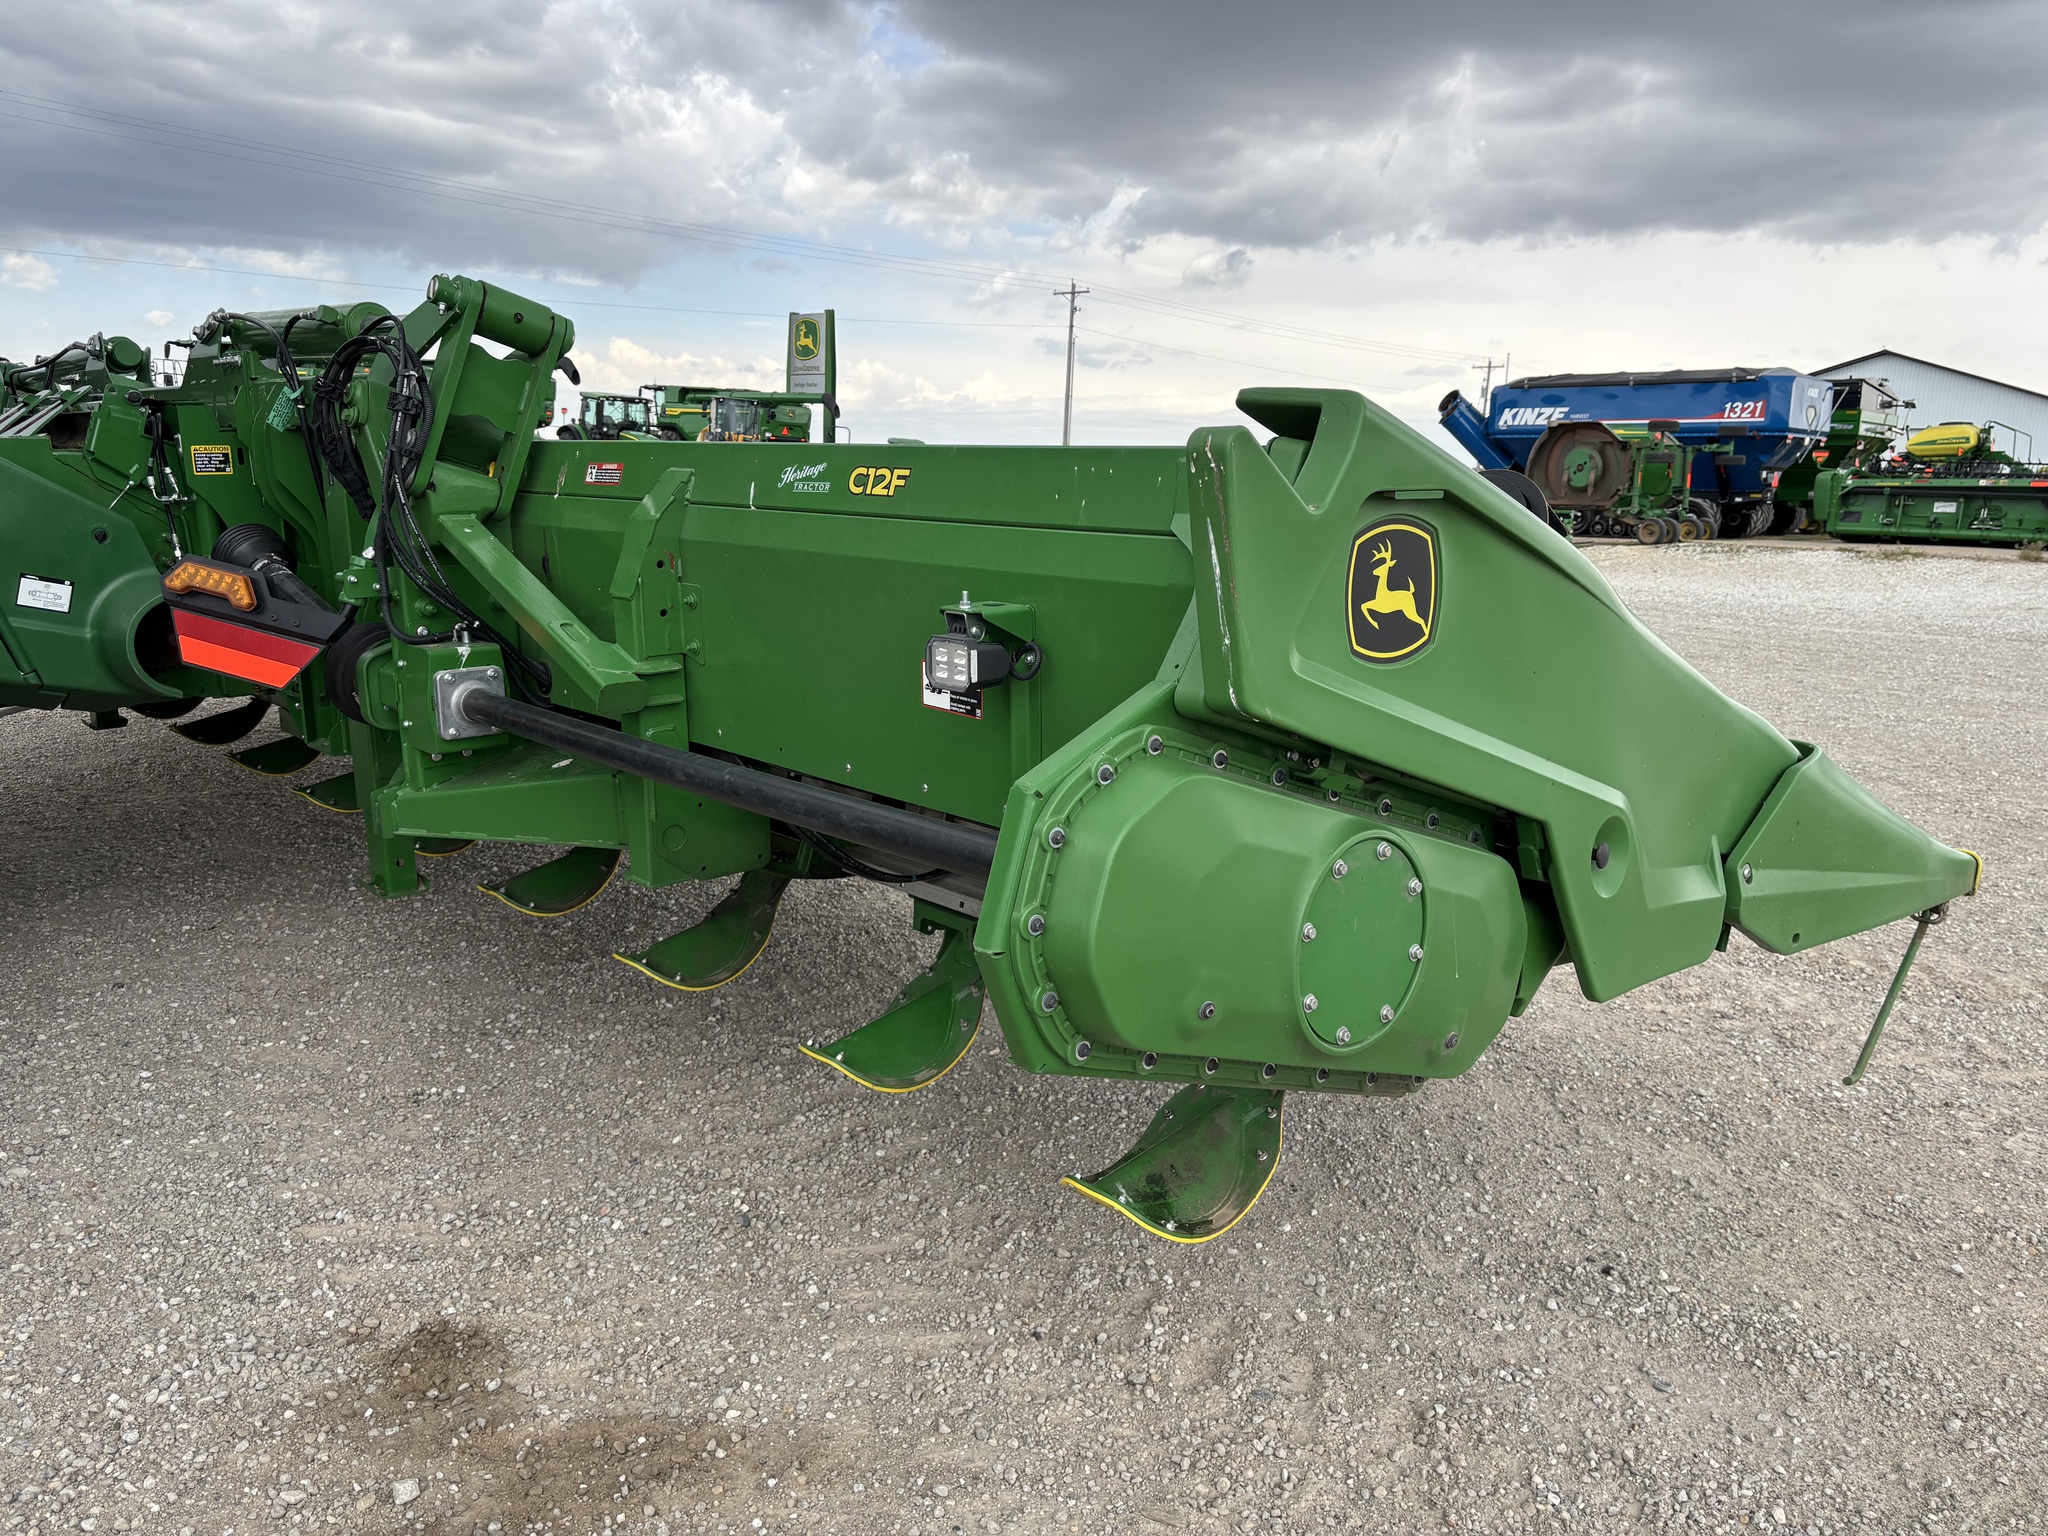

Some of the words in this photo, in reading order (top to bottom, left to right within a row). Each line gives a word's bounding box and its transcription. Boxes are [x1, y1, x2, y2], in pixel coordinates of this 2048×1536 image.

[1498, 407, 1570, 426] KINZE
[1723, 401, 1763, 418] 1321
[778, 462, 827, 488] Heritage
[848, 466, 911, 497] C12F
[793, 482, 831, 492] TRACTOR
